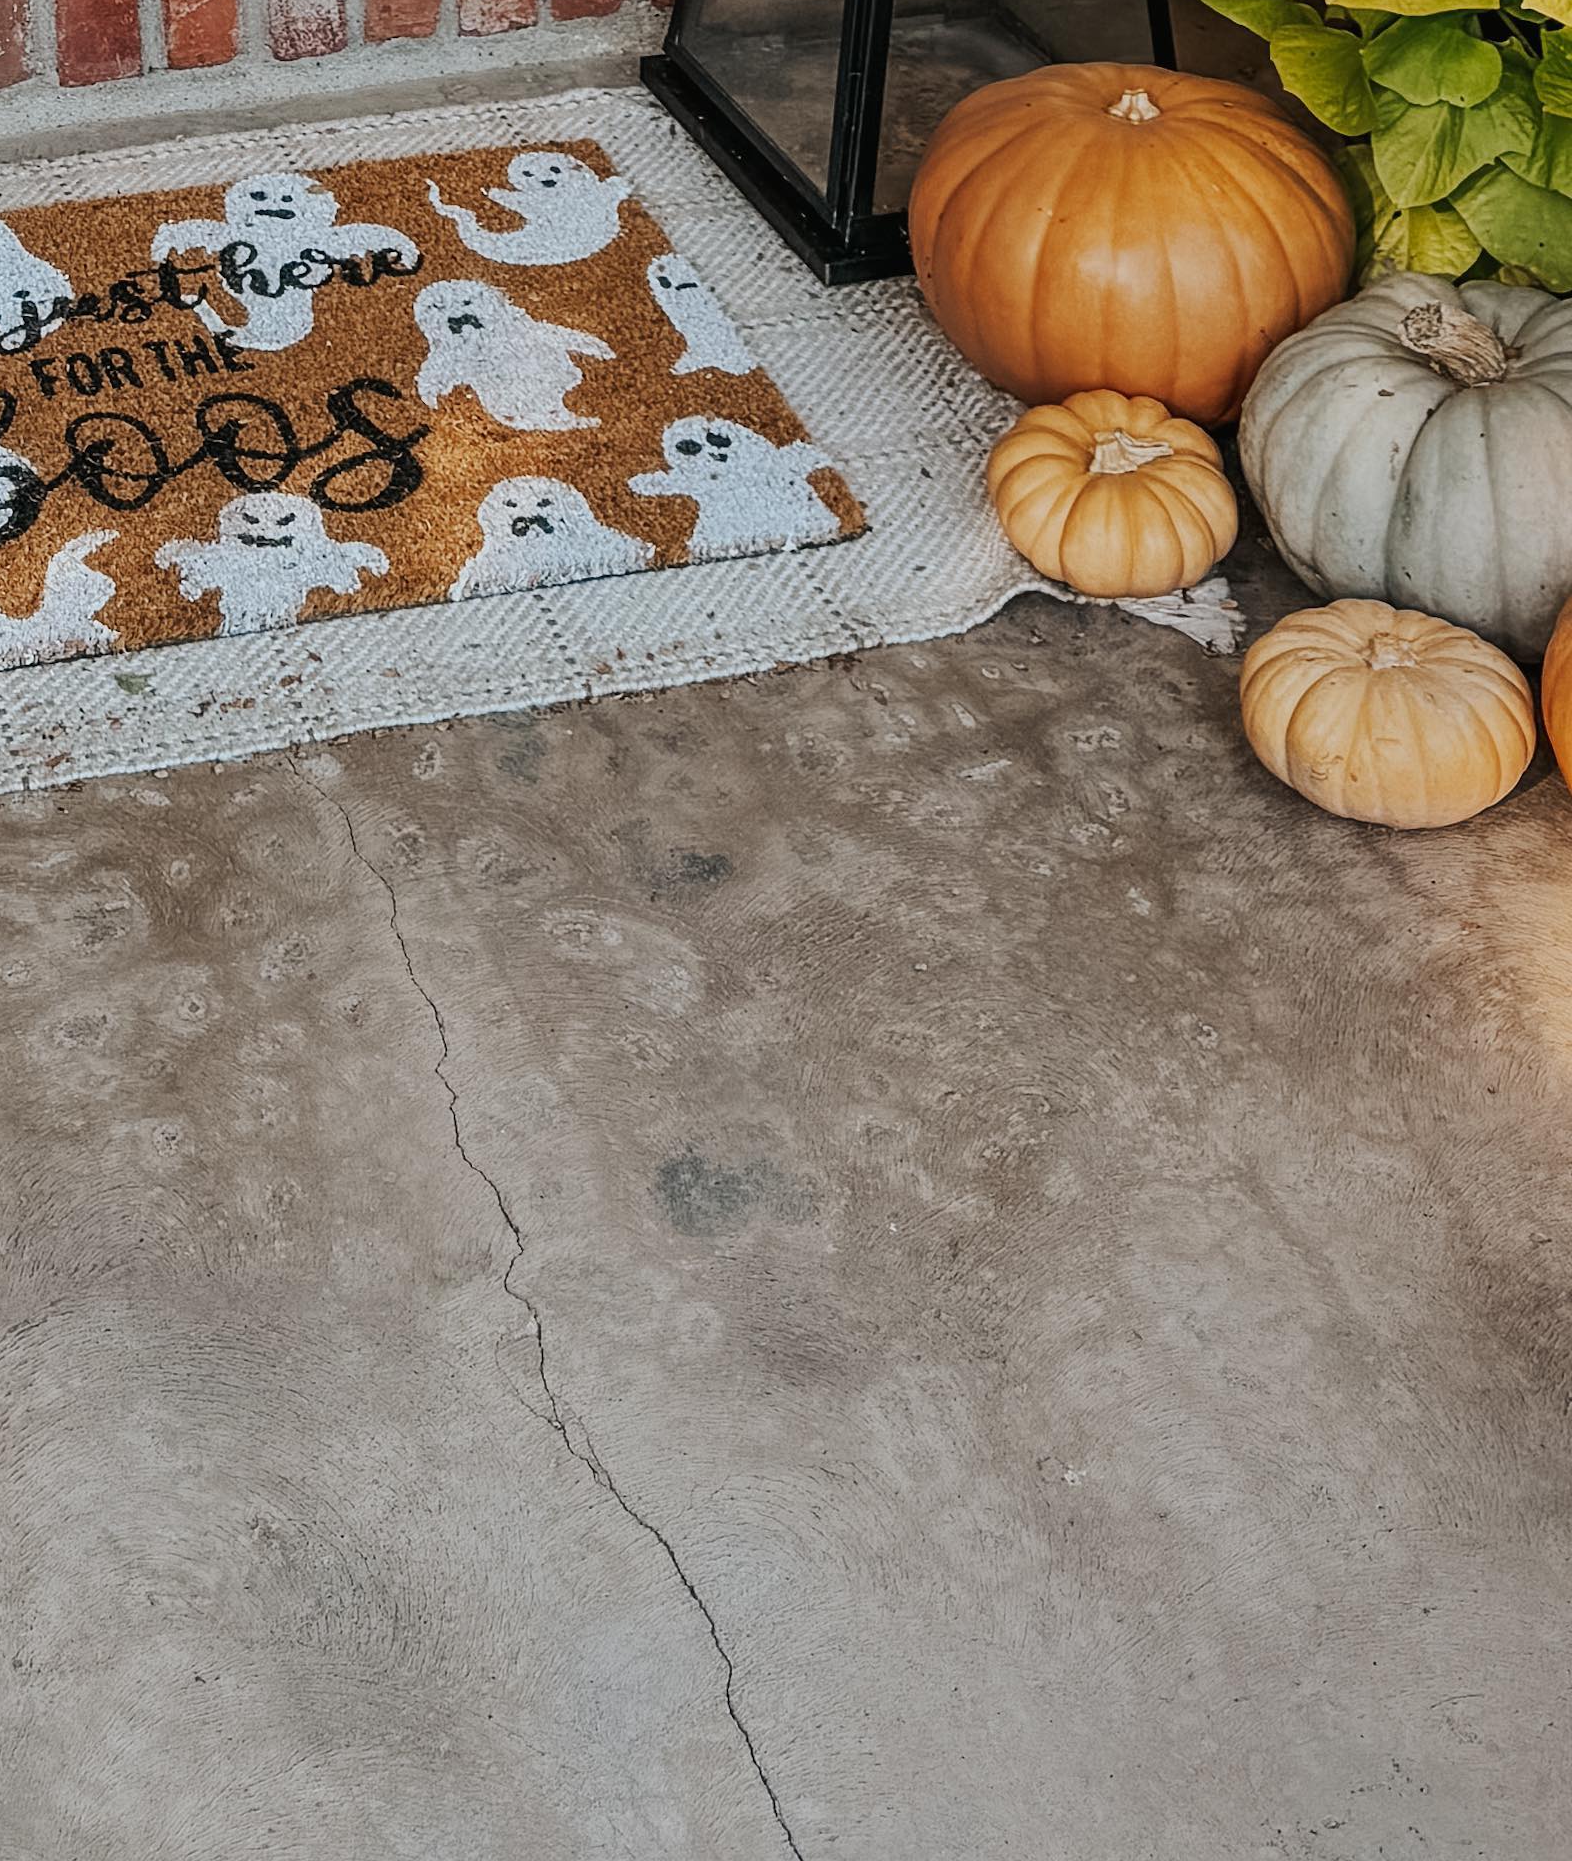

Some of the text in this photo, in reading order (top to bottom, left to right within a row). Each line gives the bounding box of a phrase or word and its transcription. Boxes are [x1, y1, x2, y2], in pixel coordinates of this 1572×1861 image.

[217, 239, 421, 298] here
[28, 329, 256, 398] FOR THE
